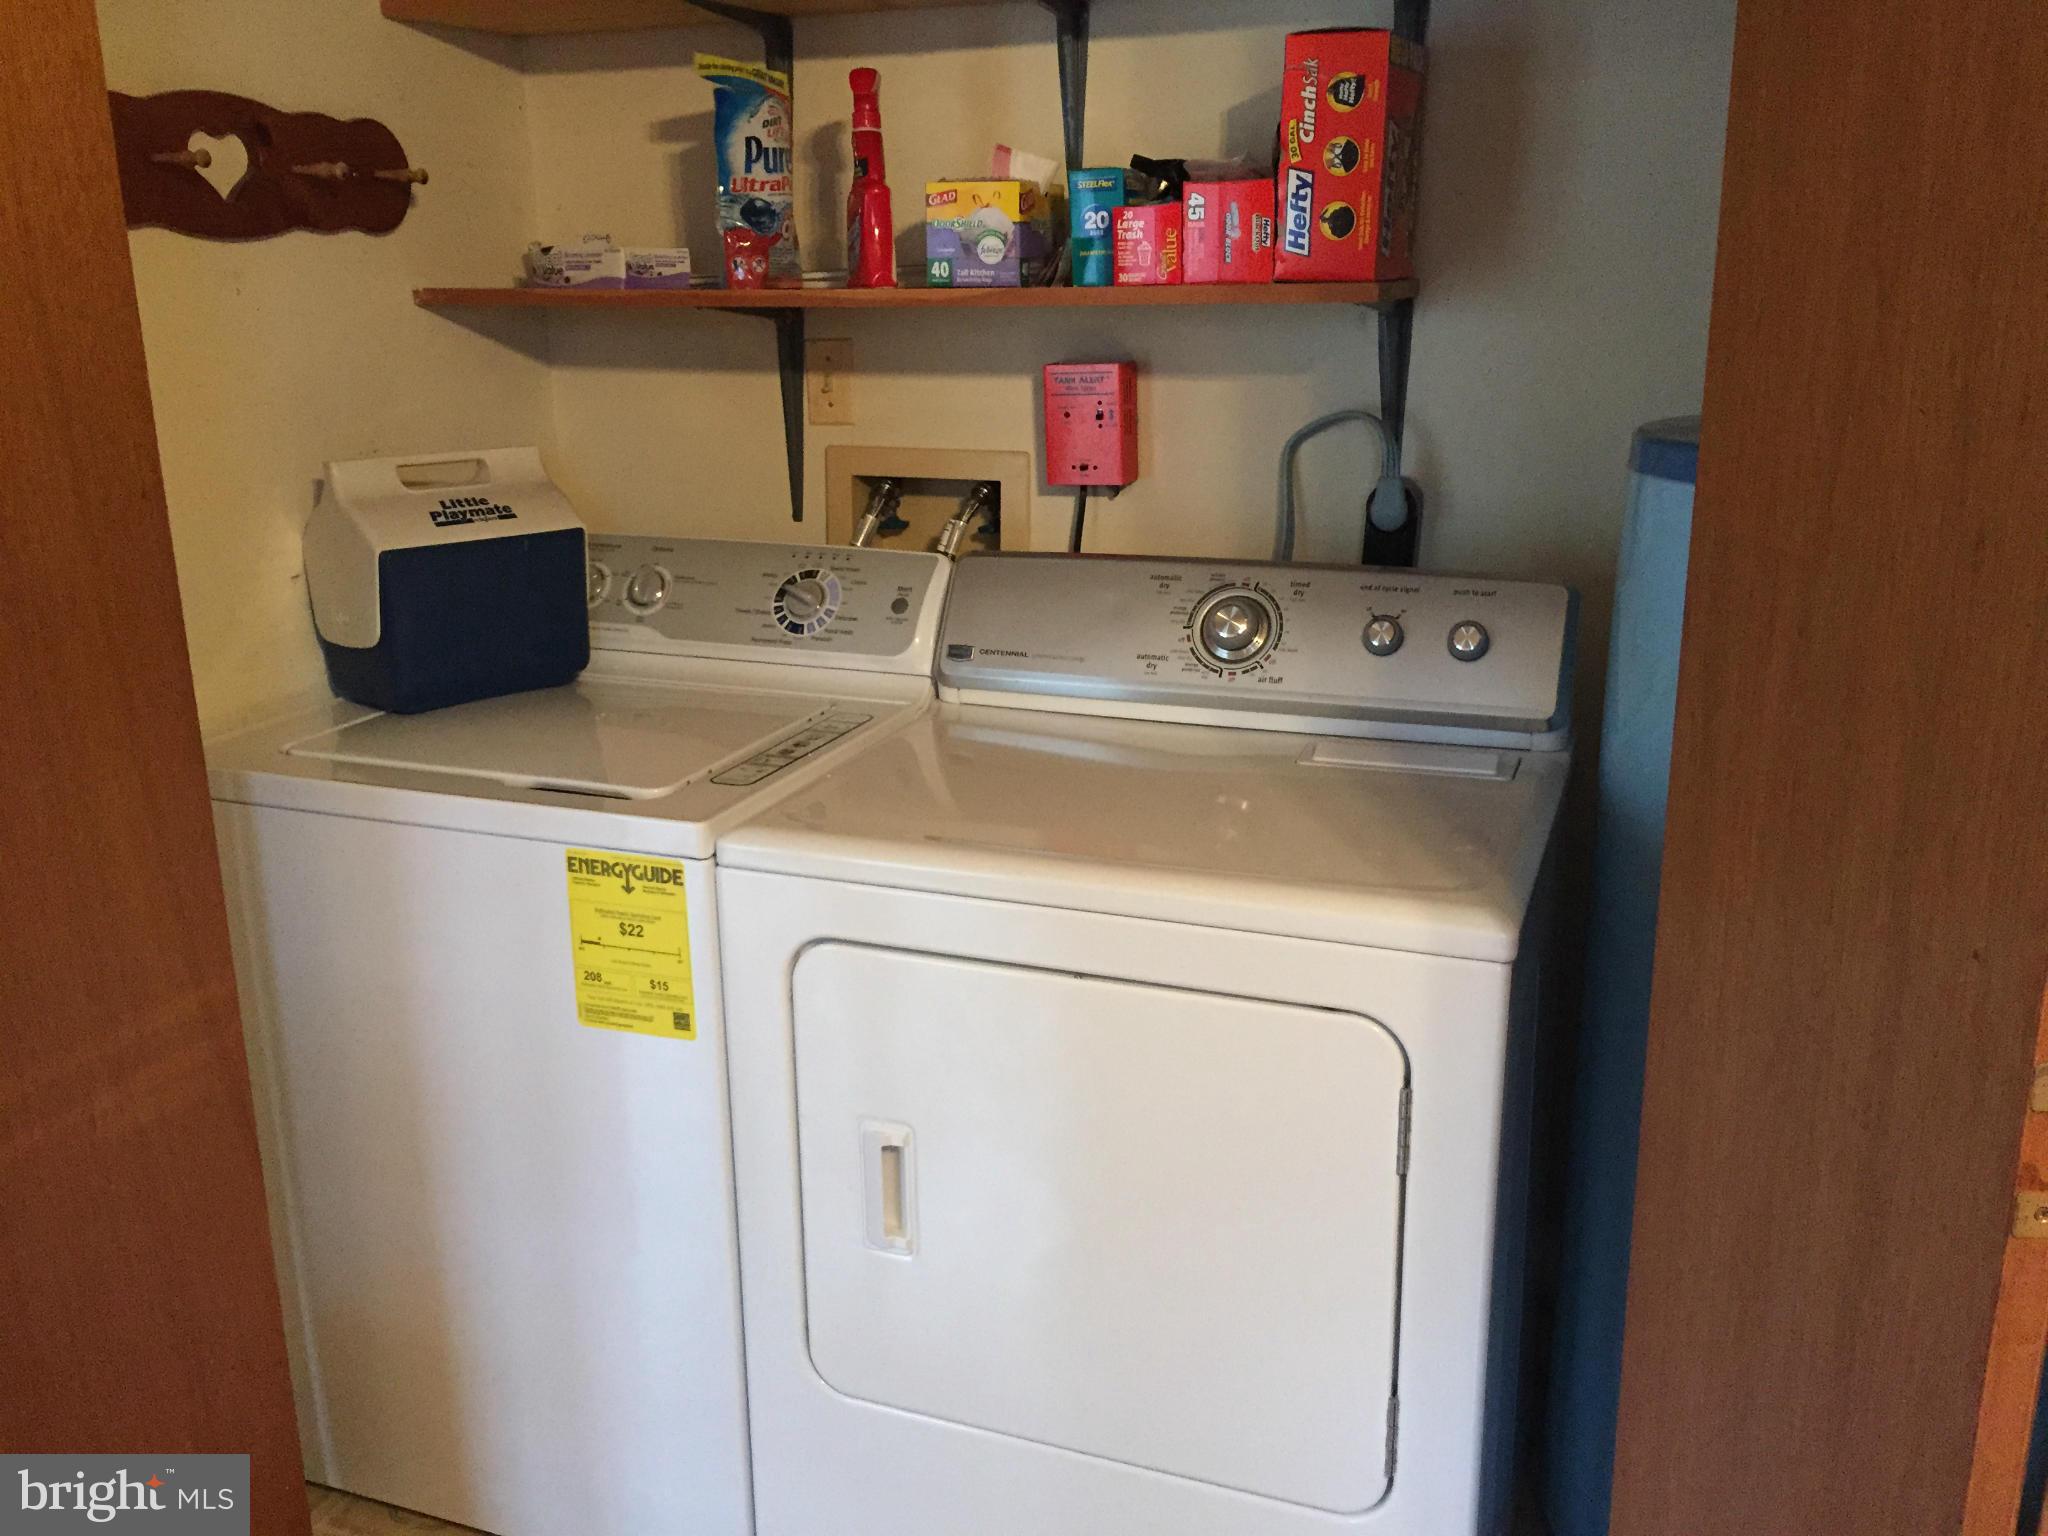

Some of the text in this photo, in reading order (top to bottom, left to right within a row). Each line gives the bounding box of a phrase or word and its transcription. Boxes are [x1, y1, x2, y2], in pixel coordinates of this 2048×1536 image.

[1299, 58, 1318, 143] CinchSak
[1290, 147, 1299, 160] 30
[928, 191, 956, 205] GLAD
[1187, 192, 1205, 220] 45
[1287, 173, 1313, 251] Hefty
[1084, 210, 1109, 229] 20
[1122, 211, 1134, 220] 20
[1117, 220, 1145, 231] Large
[1117, 230, 1143, 239] Trash
[931, 261, 950, 278] 40
[439, 497, 489, 509] Little
[429, 504, 513, 521] Playmate
[979, 648, 1029, 658] CENTENNIAL
[567, 856, 684, 887] ENERGYGUIDE
[619, 922, 644, 938] $22
[649, 979, 669, 991] $15
